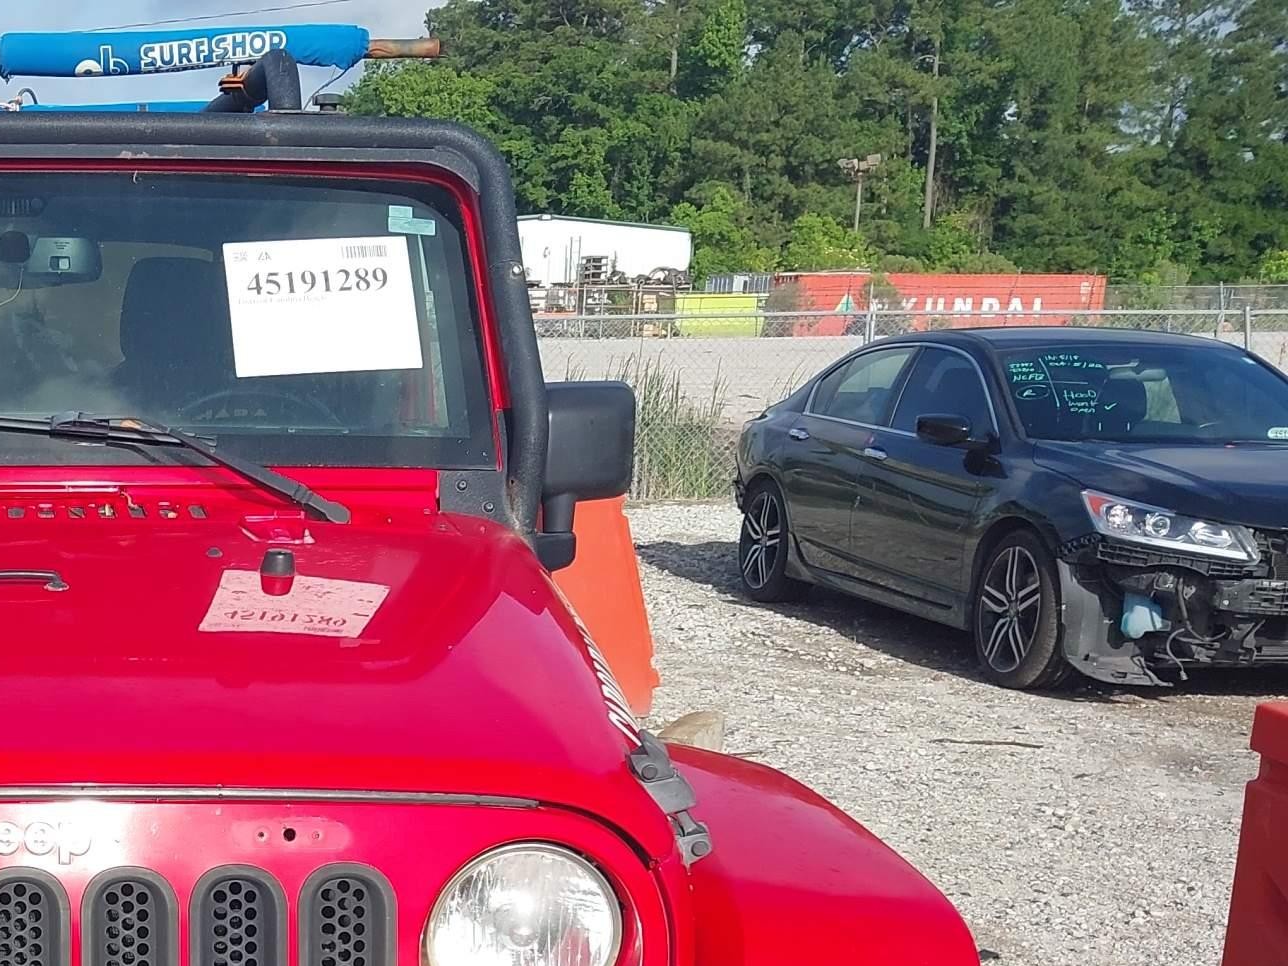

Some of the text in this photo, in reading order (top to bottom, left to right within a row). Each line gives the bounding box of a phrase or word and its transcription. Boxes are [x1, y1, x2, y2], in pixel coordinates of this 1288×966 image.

[140, 38, 209, 69] SURF
[211, 31, 288, 62] SHOP
[247, 267, 388, 296] 45191289
